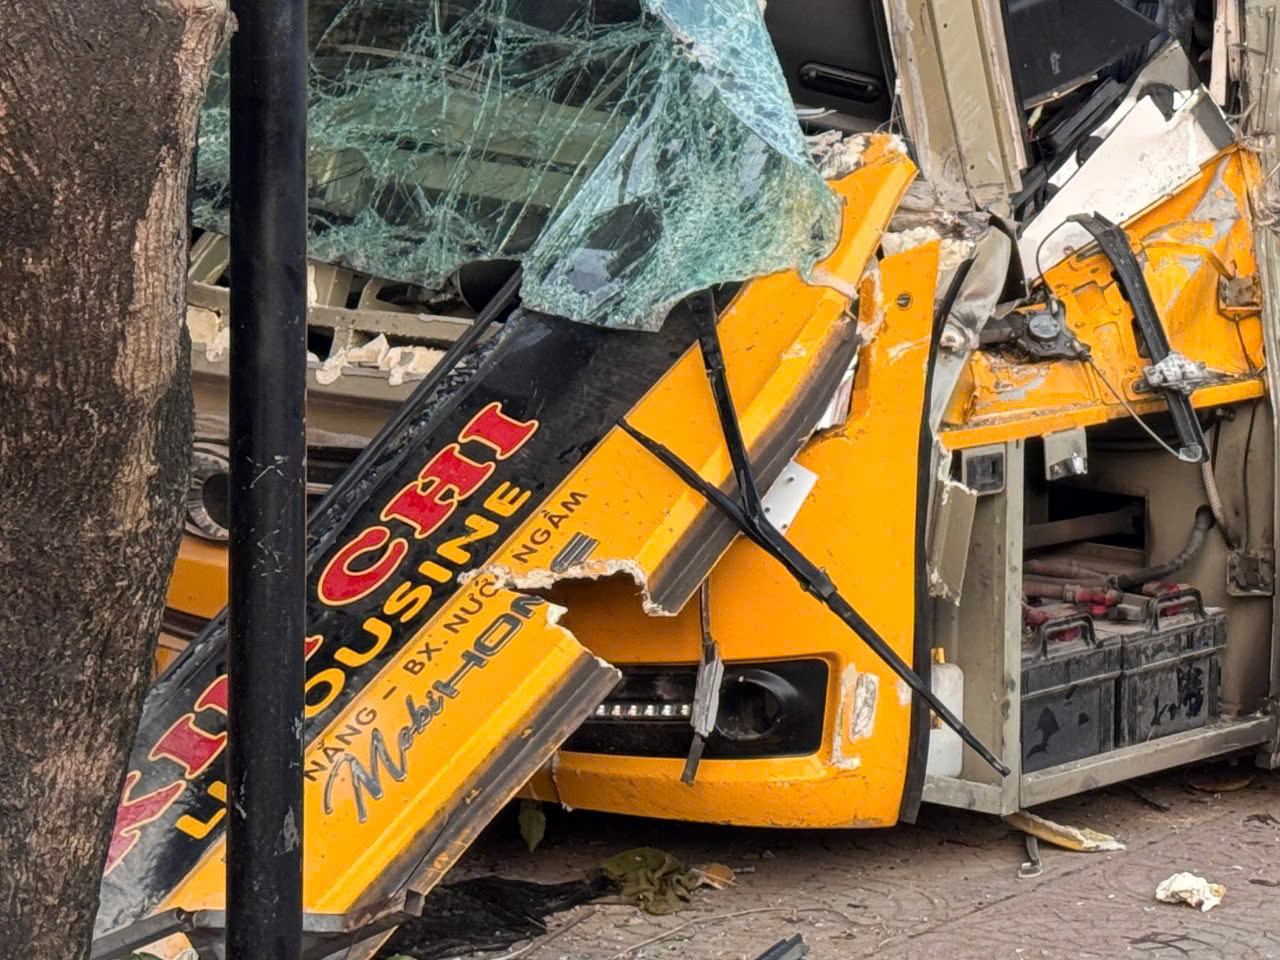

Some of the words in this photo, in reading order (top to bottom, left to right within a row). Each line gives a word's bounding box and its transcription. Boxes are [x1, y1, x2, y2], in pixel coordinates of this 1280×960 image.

[318, 401, 538, 605] CHI
[443, 573, 500, 634] NƯỚ
[512, 491, 588, 563] NGẦM
[176, 481, 532, 839] LIOUSINE
